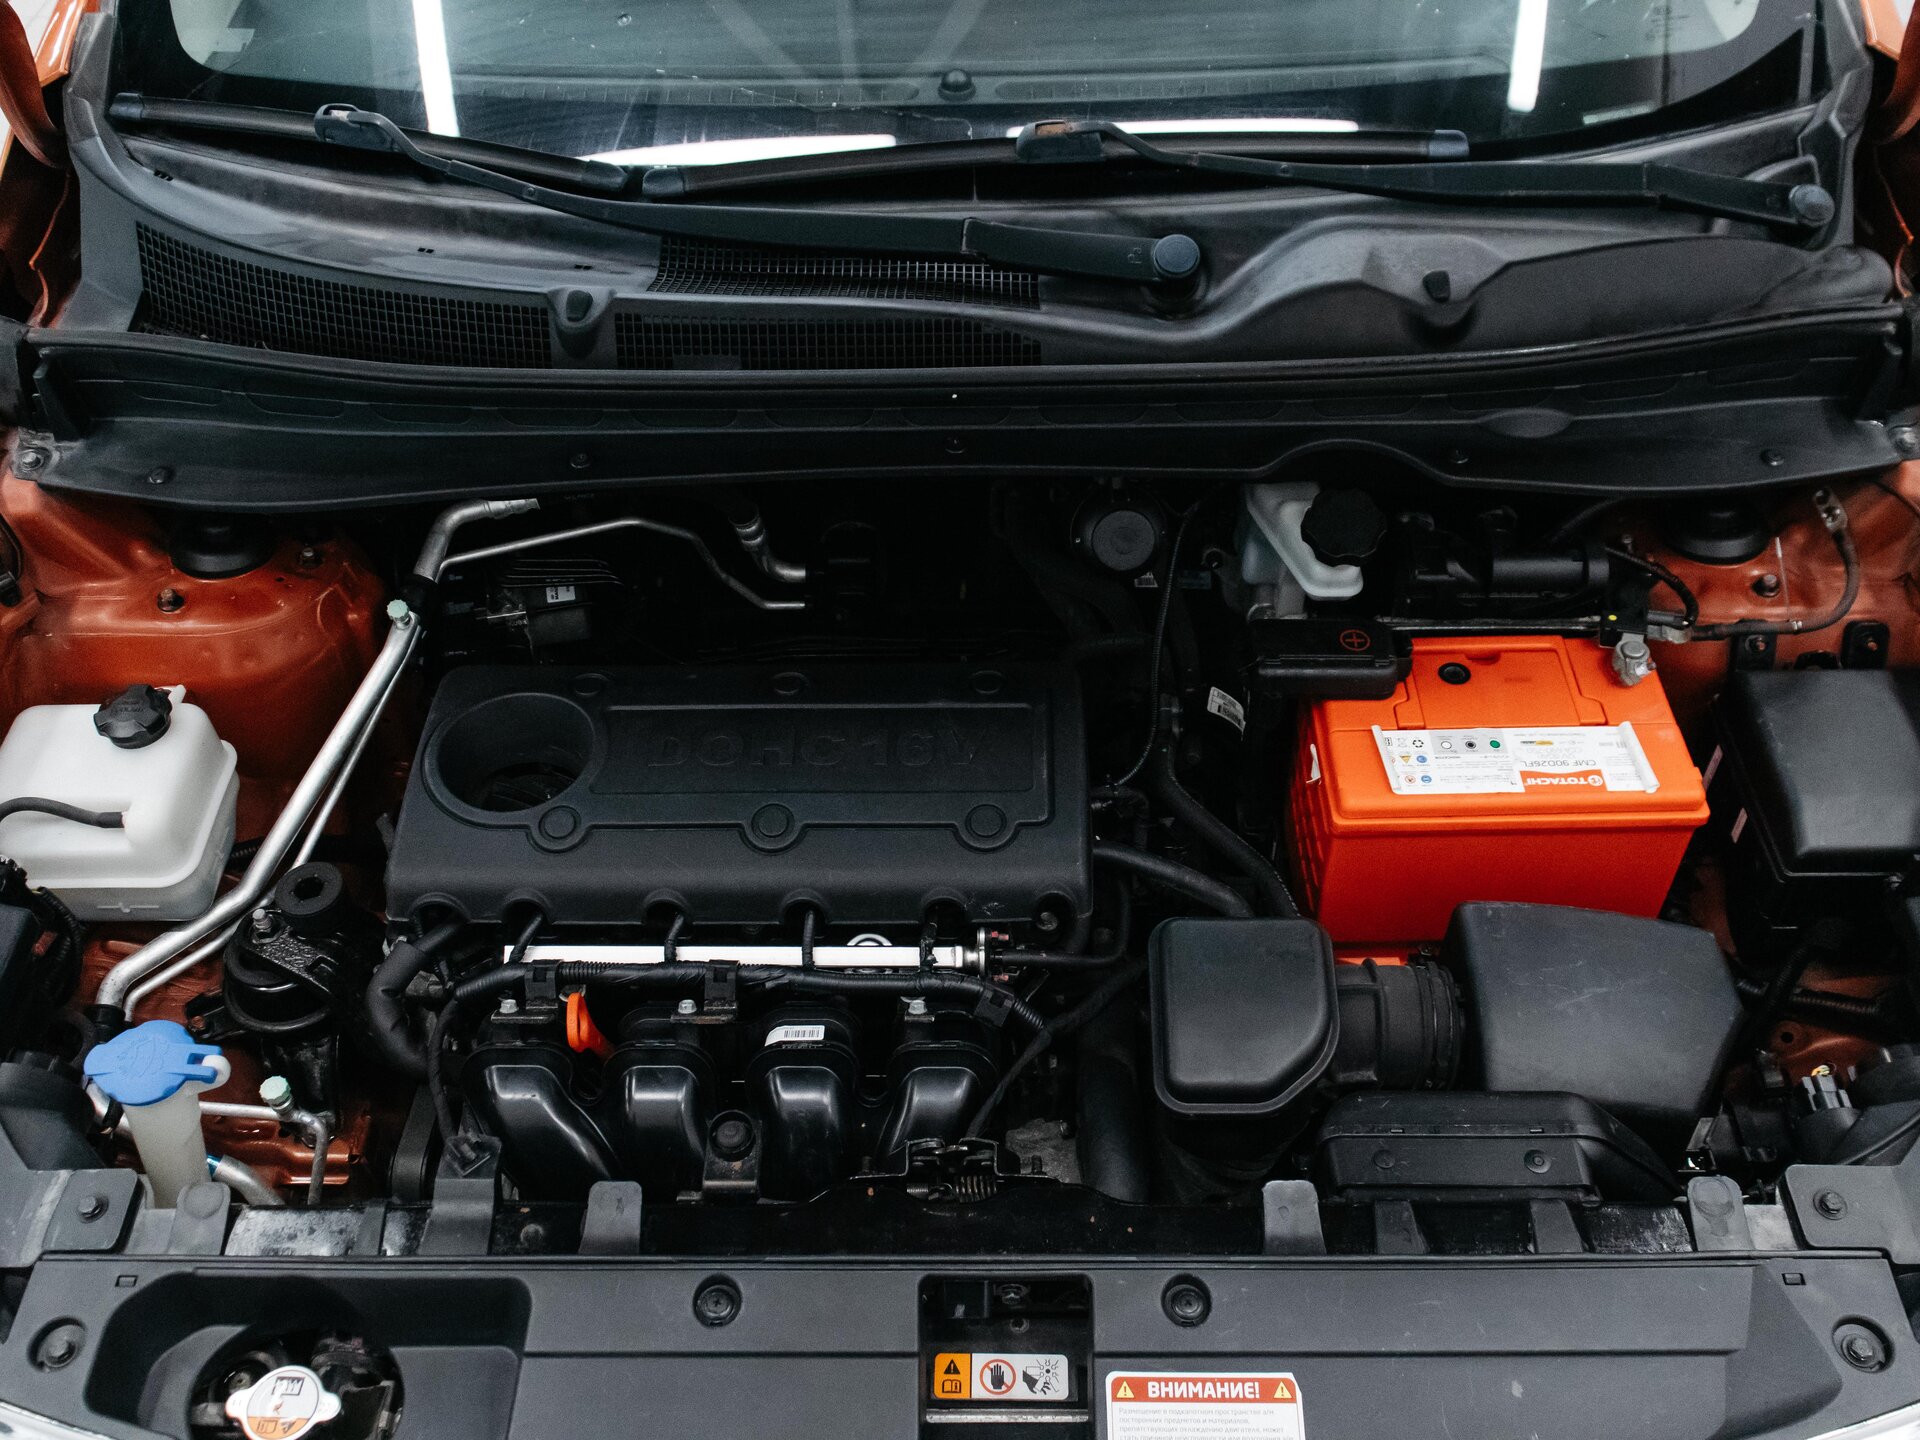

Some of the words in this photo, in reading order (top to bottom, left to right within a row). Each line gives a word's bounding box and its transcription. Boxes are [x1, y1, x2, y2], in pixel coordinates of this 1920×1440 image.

[647, 727, 846, 767] DOHC
[1573, 759, 1597, 767] CMF
[1526, 776, 1588, 786] TOTACHI
[1147, 1381, 1260, 1399] ВНИМАНИЕ!
